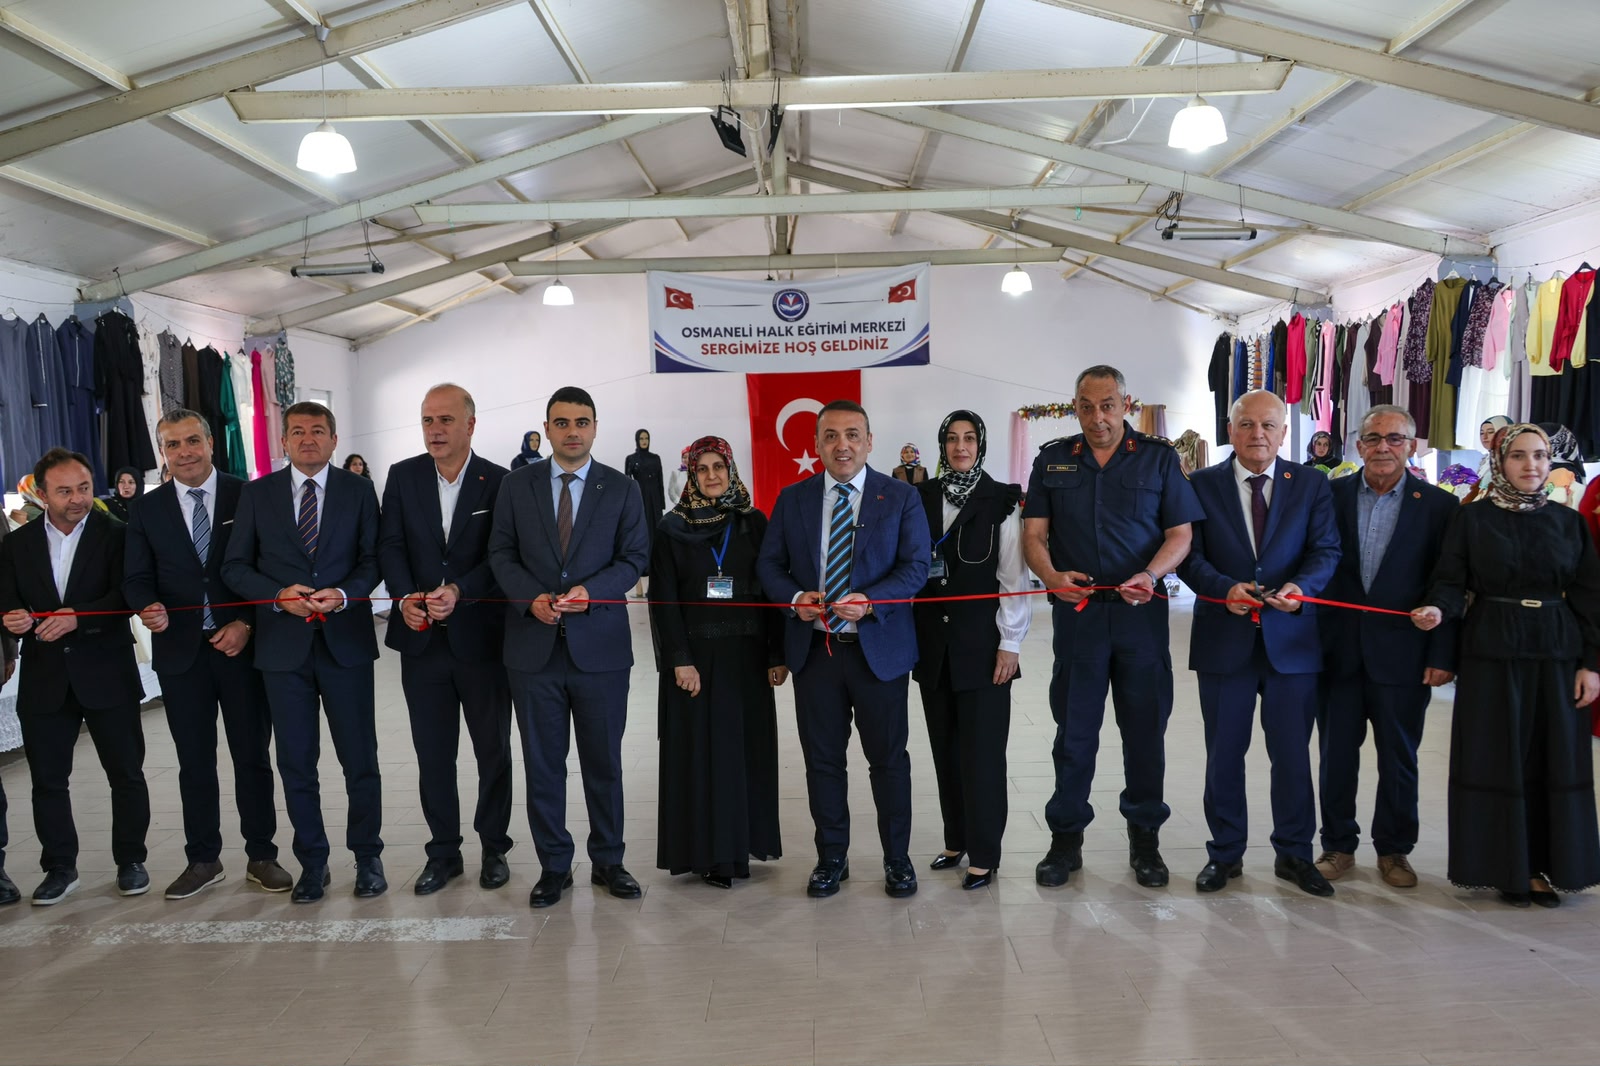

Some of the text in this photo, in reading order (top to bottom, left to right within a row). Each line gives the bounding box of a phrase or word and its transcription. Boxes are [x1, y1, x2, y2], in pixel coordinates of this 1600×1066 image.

[681, 317, 906, 338] OSMANELİ HALK EĞİTİMİ MERKEZİ
[700, 335, 889, 356] SERGİMİZE HOŞ GELDİNİZ
